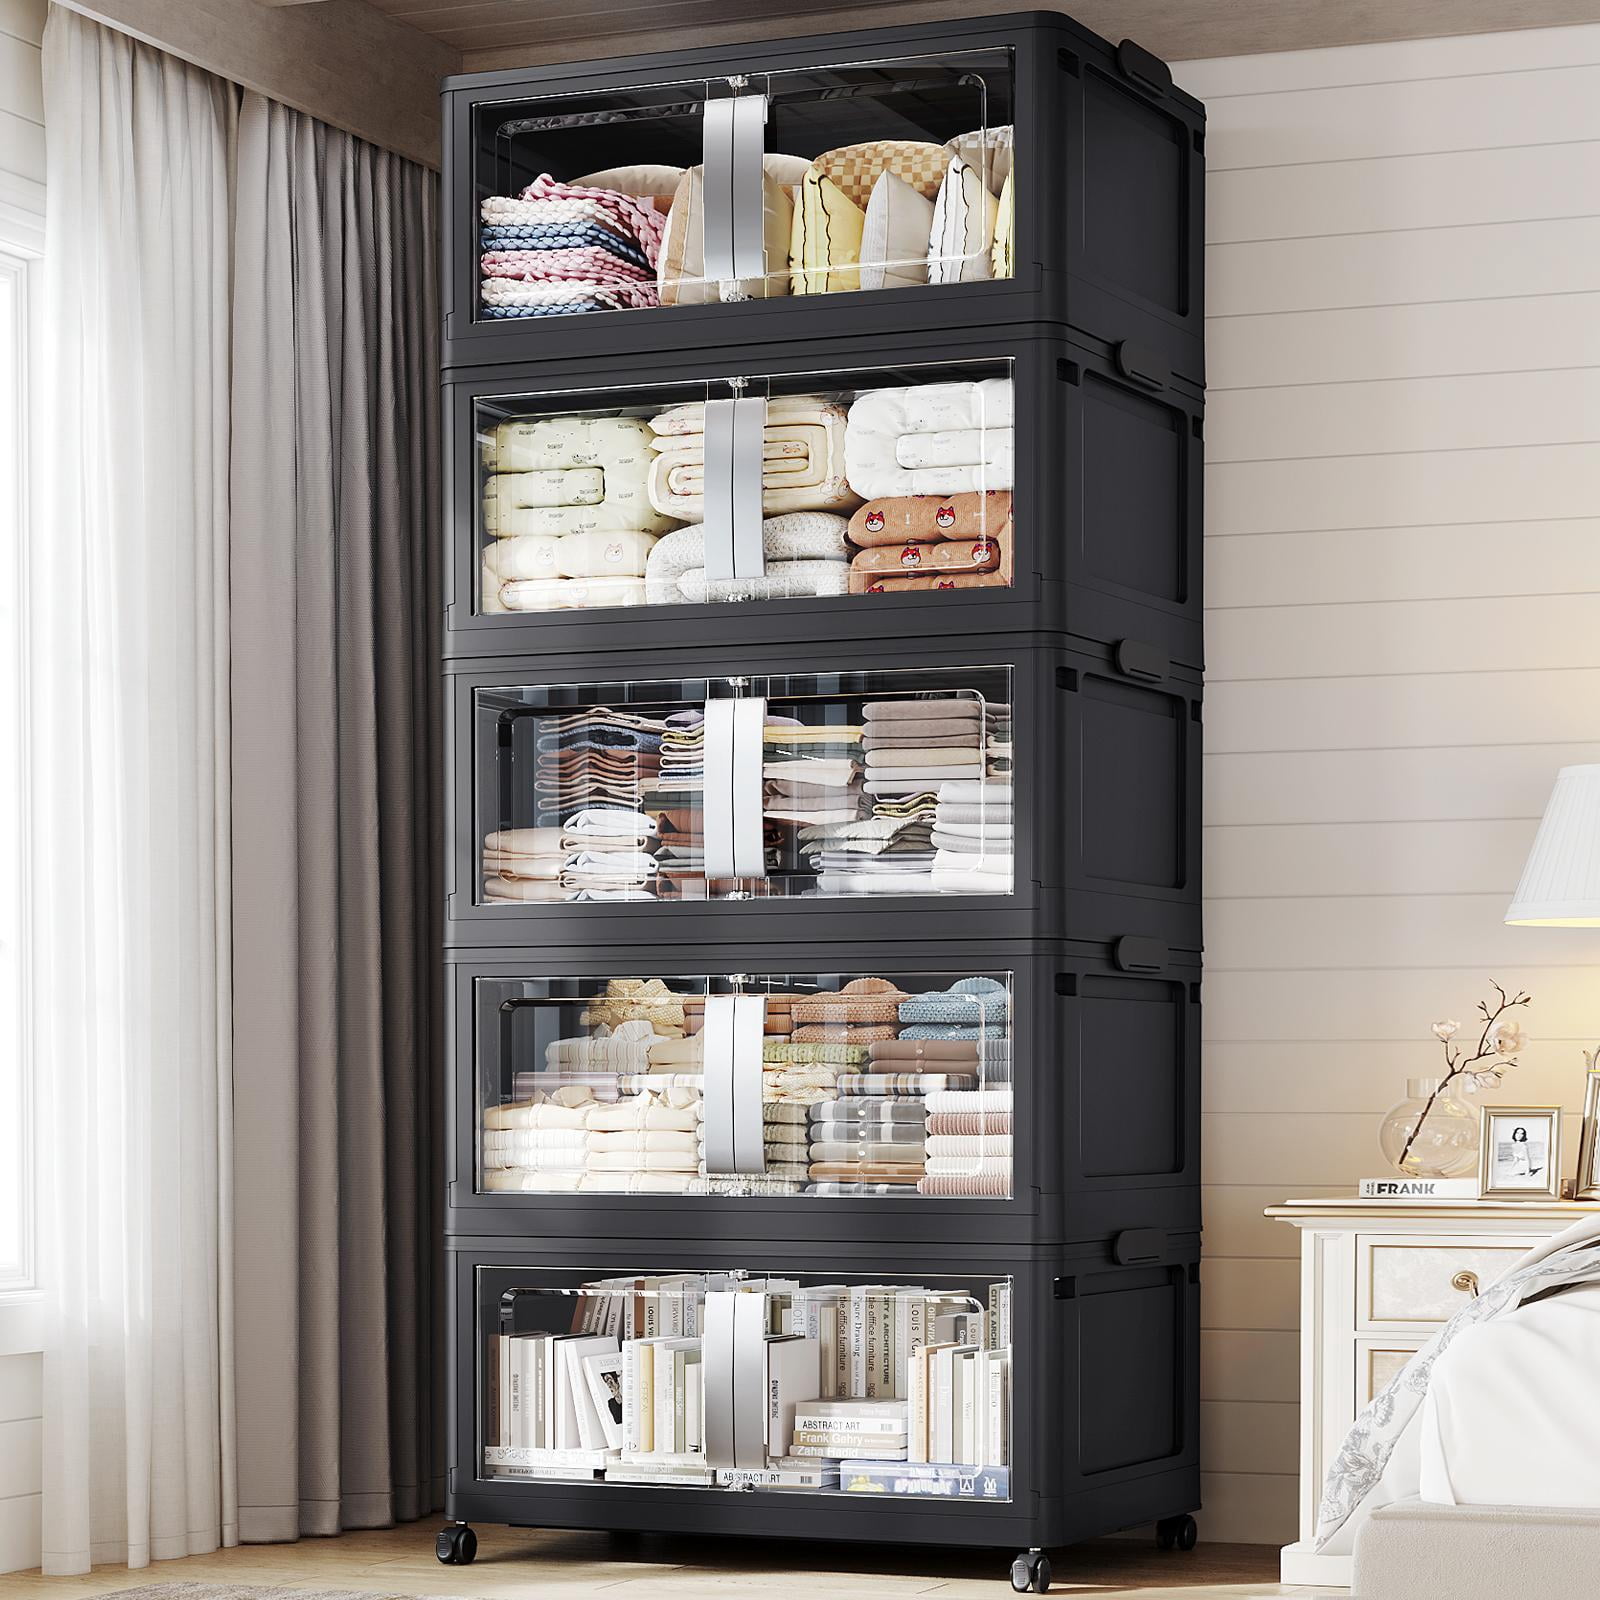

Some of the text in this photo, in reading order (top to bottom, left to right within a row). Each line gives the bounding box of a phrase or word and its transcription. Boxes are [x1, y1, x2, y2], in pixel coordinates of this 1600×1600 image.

[1376, 1183, 1436, 1194] FRANK
[911, 1304, 922, 1331] Louis
[839, 1336, 848, 1372] furniture
[868, 1336, 877, 1373] furniture
[802, 1420, 861, 1430] ABSTRACT ART
[800, 1432, 863, 1447] Frank Gehry
